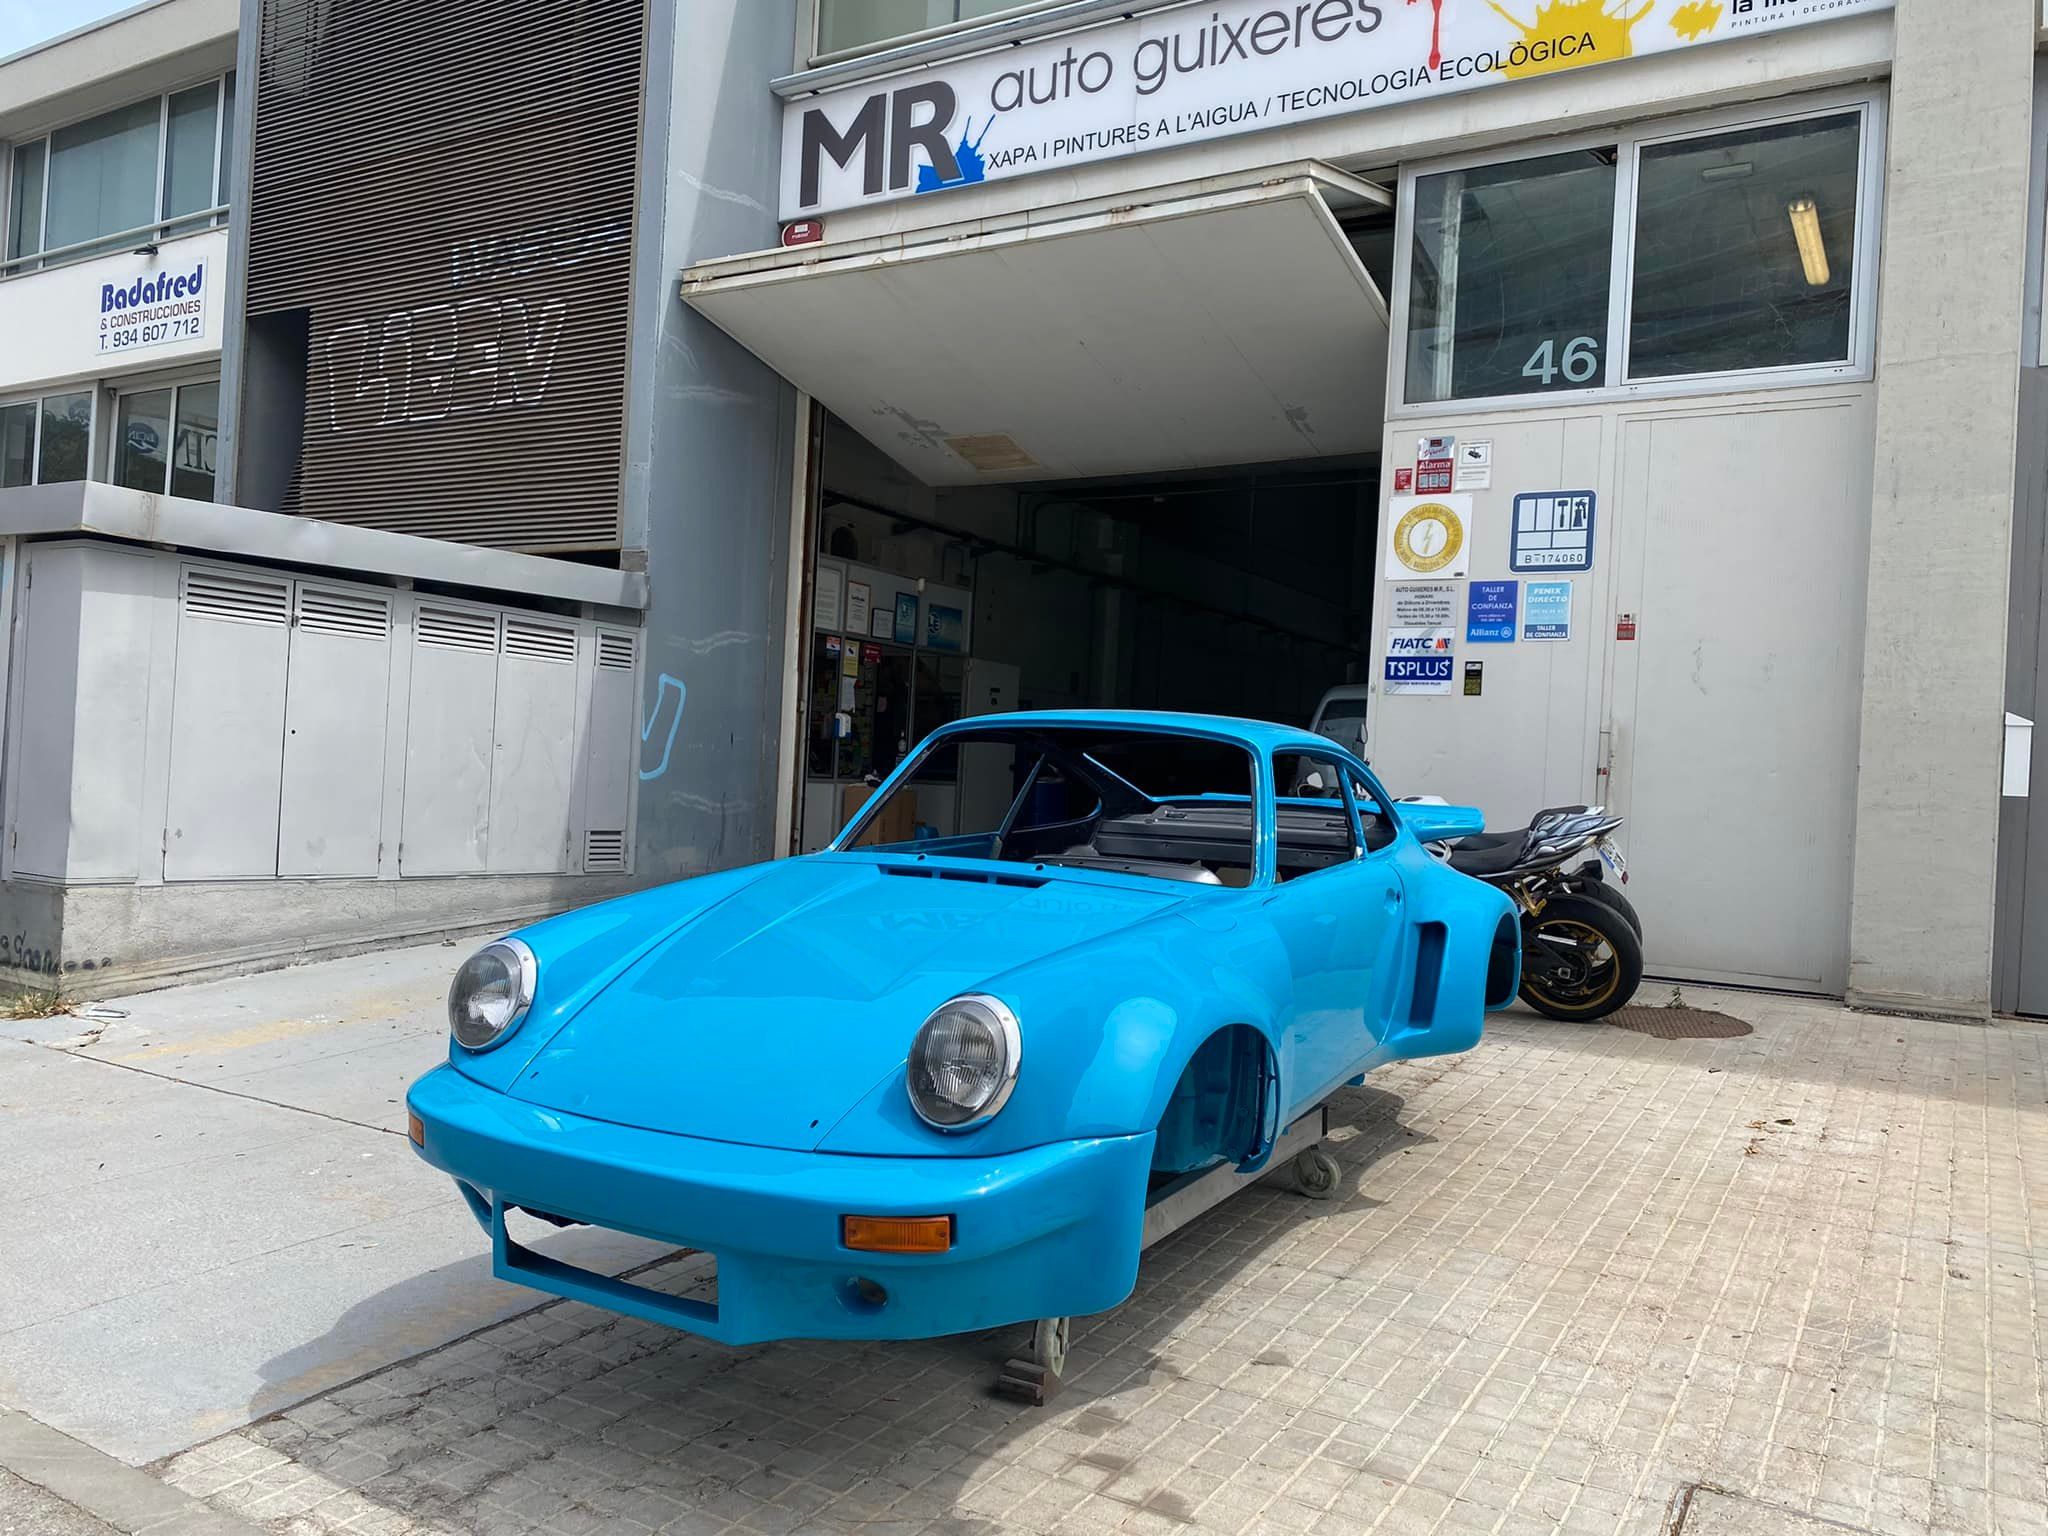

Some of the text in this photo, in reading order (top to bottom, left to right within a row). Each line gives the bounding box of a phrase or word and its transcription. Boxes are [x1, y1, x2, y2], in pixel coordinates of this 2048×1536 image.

[1731, 13, 1785, 28] PINTURA
[991, 0, 1382, 112] auto guixeres
[989, 145, 1037, 169] XAPA
[1054, 122, 1150, 157] PINTURES
[1155, 119, 1170, 137] A
[1176, 101, 1258, 133] L'AIGUA
[1277, 66, 1431, 113] TECNOLOGIA
[1439, 32, 1596, 81] ECOLÒGICA
[800, 80, 962, 208] MR
[101, 264, 203, 313] Badafred
[100, 300, 201, 330] & CONSTRUCCIONES
[99, 317, 200, 350] T. 934 607 712
[1522, 336, 1599, 385] 46
[1418, 461, 1451, 469] Alarma
[1471, 602, 1513, 610] CONFIANZA
[1527, 595, 1568, 603] DIRECTO
[1391, 638, 1433, 649] FIATC
[1470, 628, 1499, 636] Allianz
